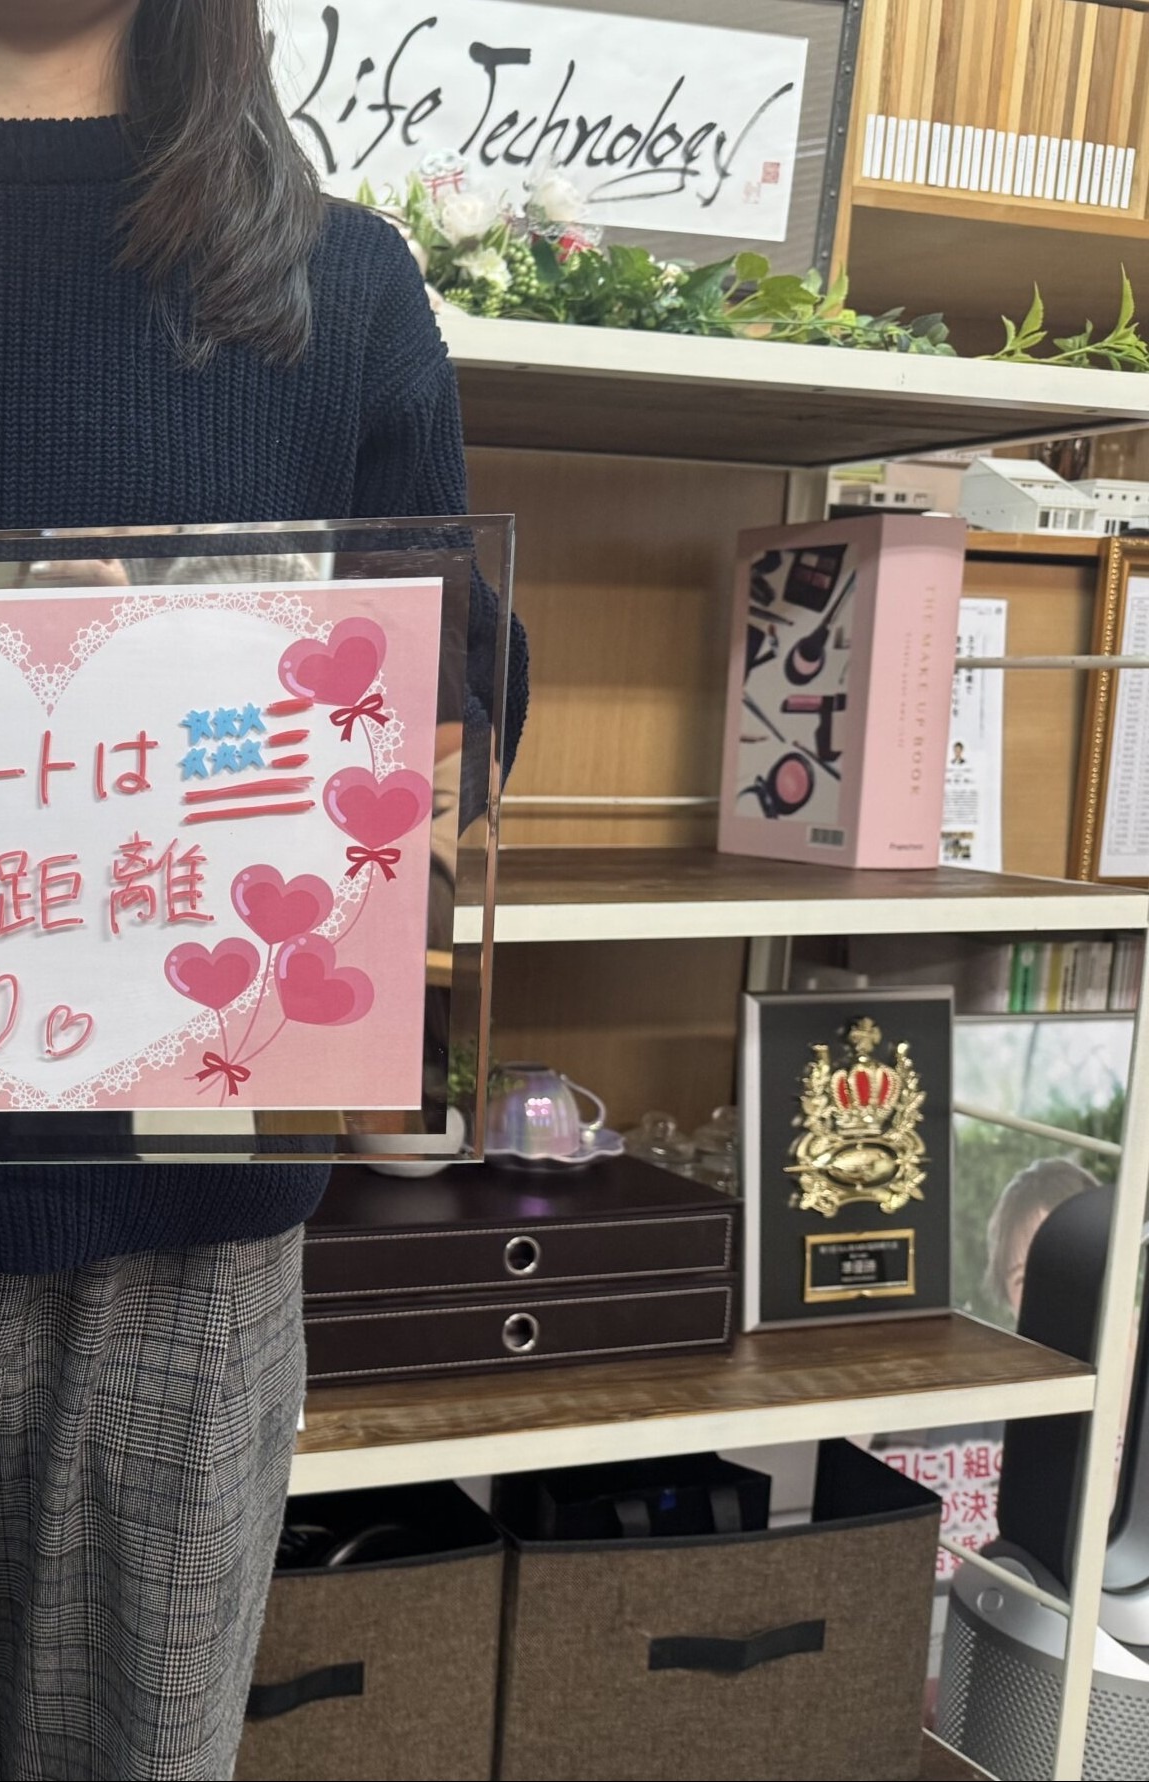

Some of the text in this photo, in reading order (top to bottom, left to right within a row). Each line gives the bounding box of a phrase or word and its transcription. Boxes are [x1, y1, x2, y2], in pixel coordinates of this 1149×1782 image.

[289, 4, 443, 175] Life
[458, 41, 794, 207] Technology
[909, 736, 925, 796] BOOK
[941, 1490, 999, 1524] が決
